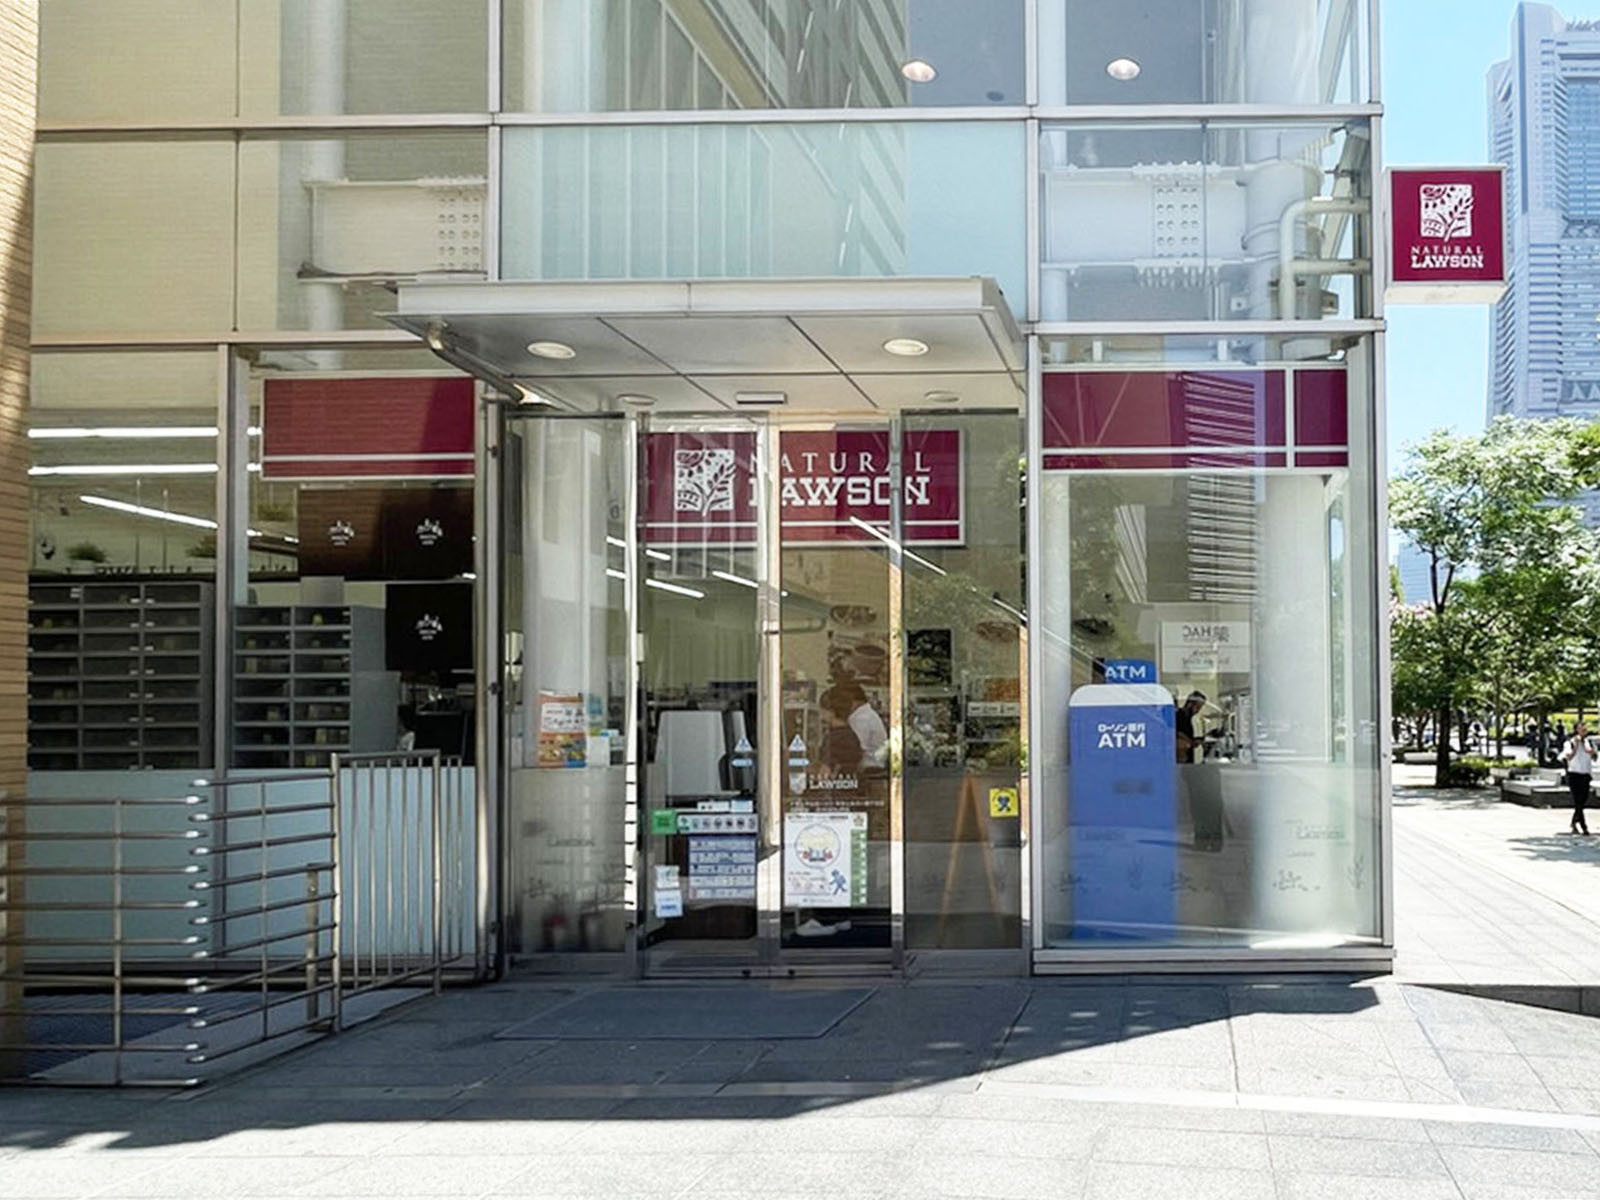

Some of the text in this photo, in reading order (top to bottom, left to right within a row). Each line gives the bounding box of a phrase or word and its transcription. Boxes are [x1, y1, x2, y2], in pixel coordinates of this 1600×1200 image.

[1411, 245, 1484, 254] NATURAL
[1411, 255, 1484, 268] LAWSON
[749, 451, 931, 473] ATURL
[1105, 665, 1146, 679] ATM
[1098, 733, 1146, 748] ATM
